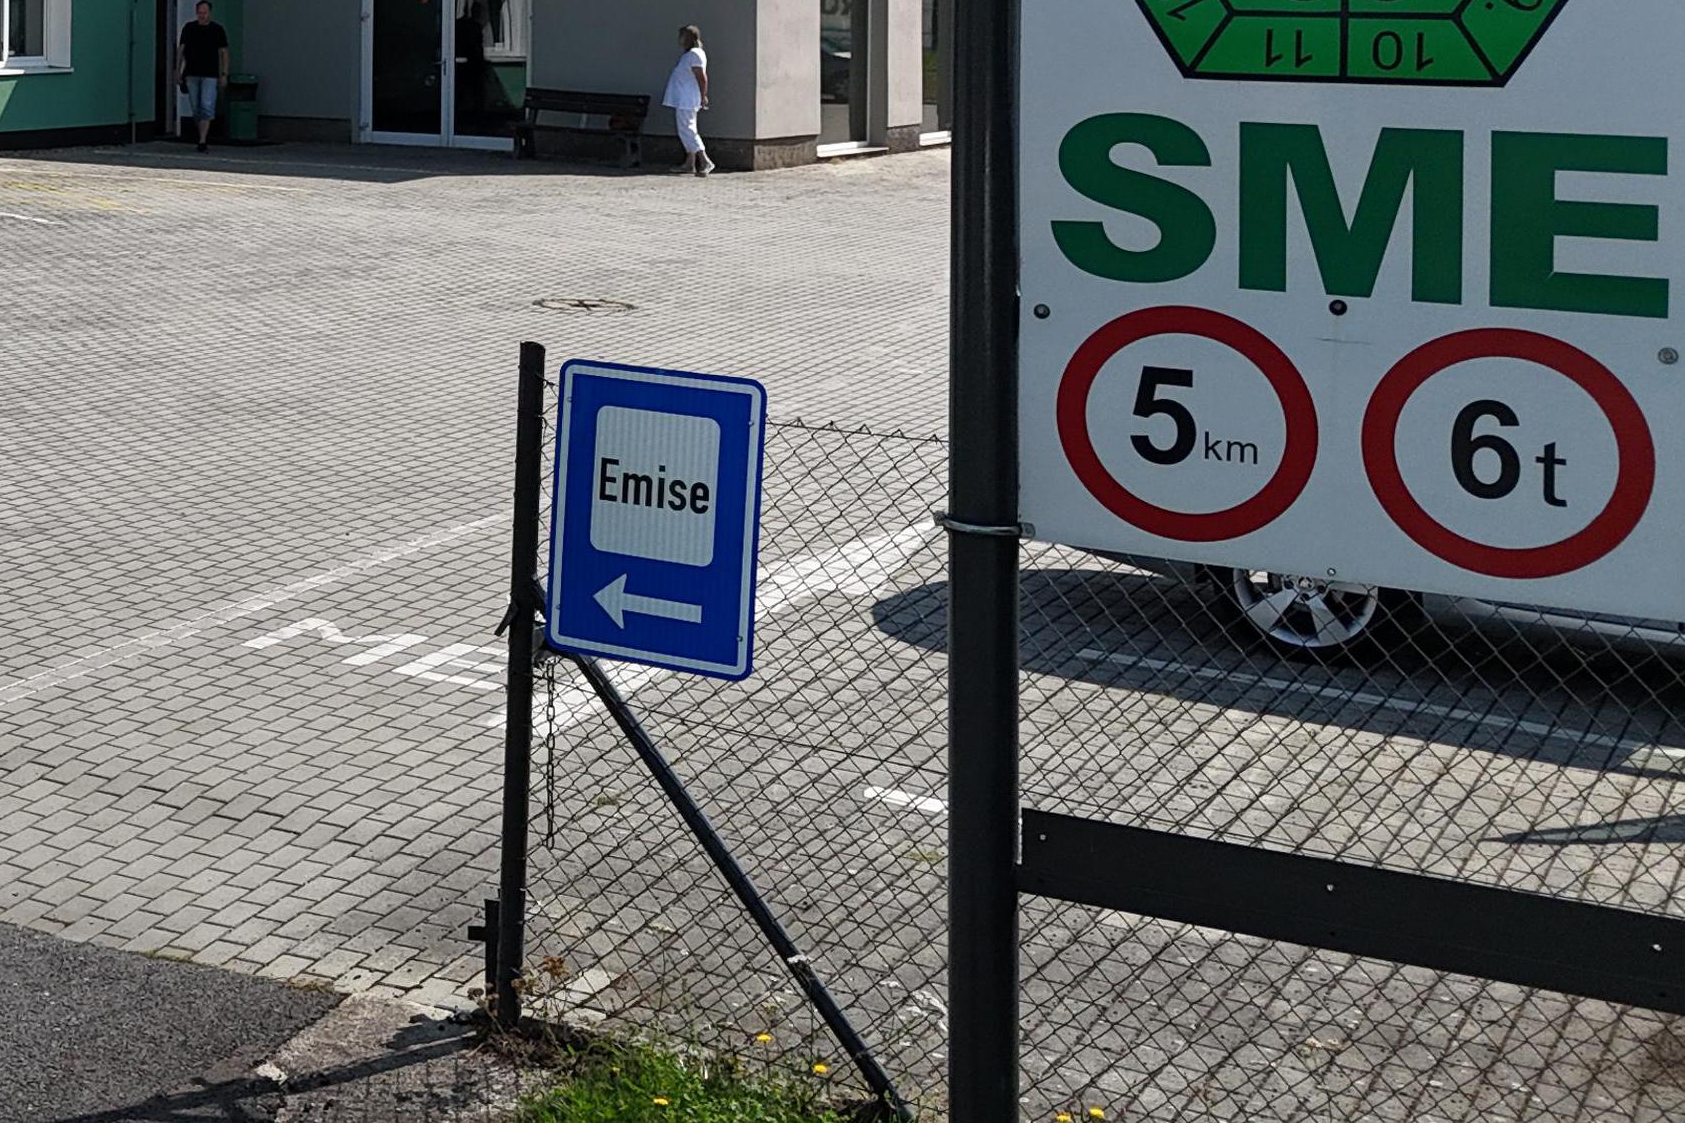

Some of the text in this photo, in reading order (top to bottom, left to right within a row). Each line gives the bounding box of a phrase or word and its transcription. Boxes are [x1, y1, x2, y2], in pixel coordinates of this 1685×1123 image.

[1264, 28, 1313, 67] 11
[1372, 30, 1433, 71] 10
[1049, 112, 1669, 319] SME
[599, 457, 710, 514] Emise
